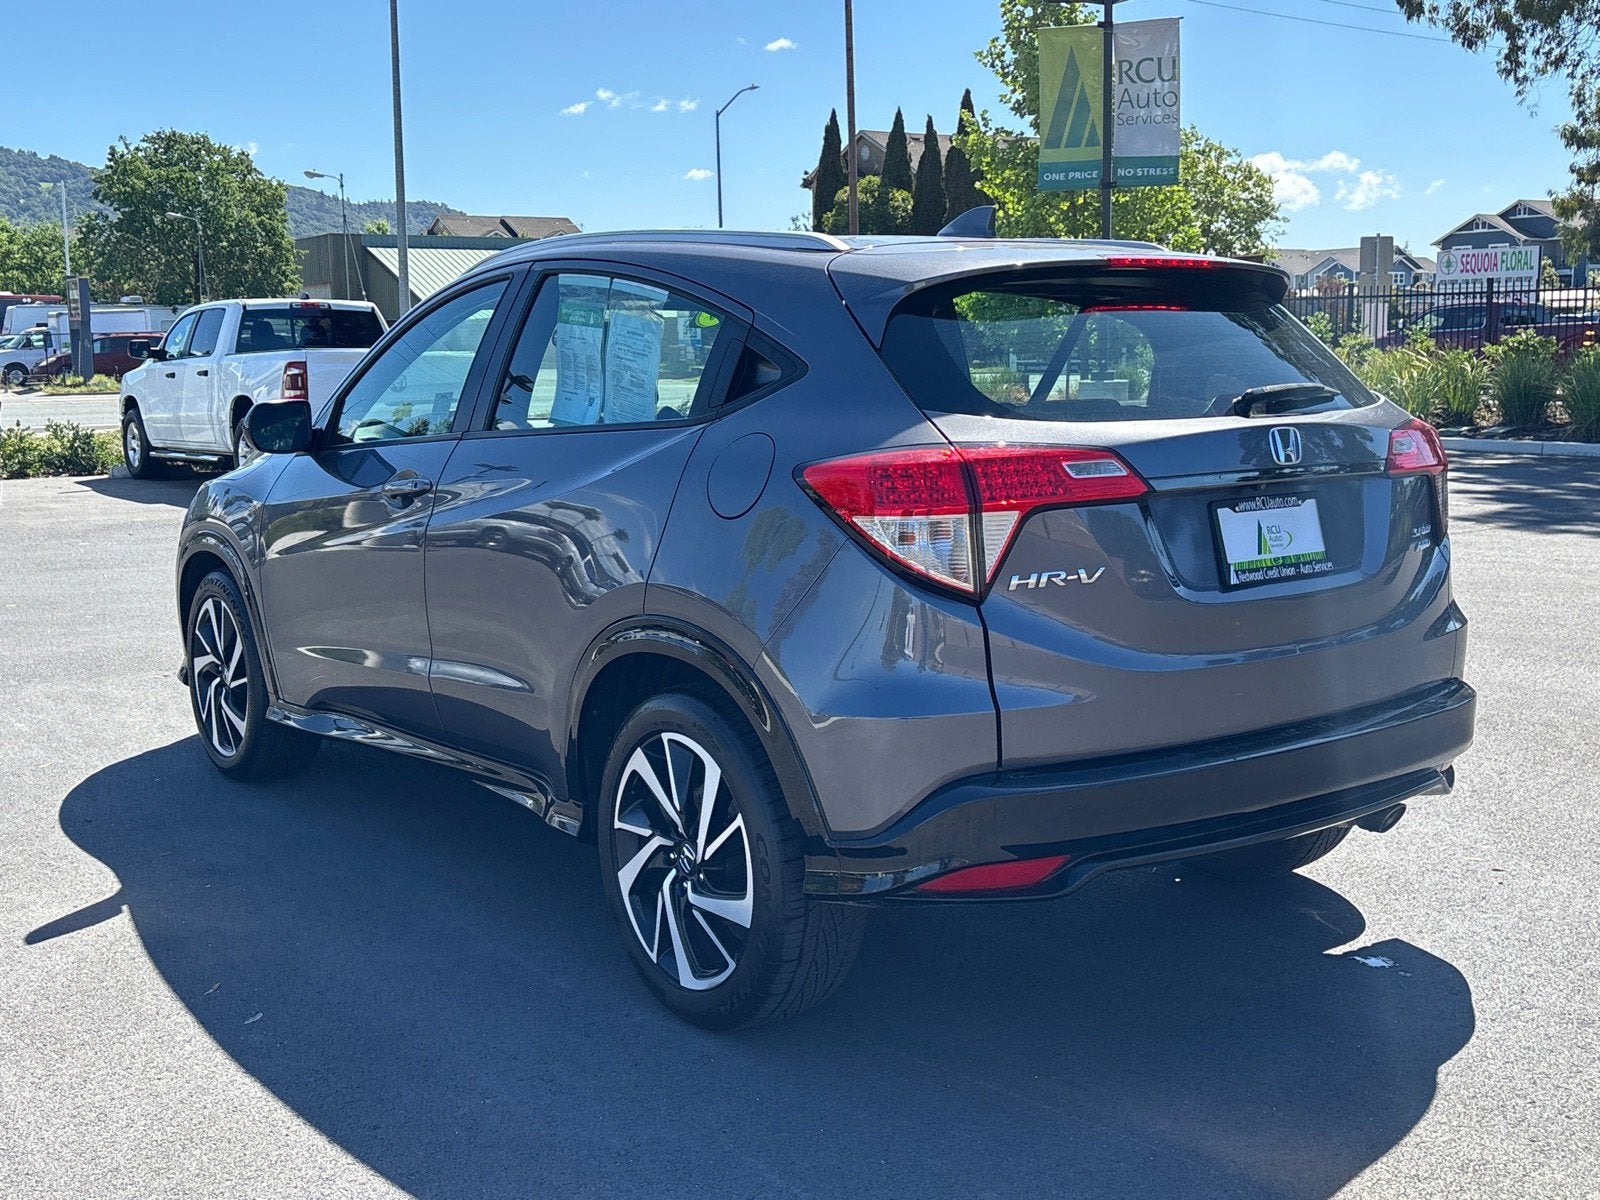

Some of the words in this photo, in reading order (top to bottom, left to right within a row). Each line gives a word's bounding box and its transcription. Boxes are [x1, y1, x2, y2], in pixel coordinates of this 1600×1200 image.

[1117, 56, 1177, 85] RCU
[1117, 88, 1178, 110] Auto
[1116, 111, 1178, 126] Services
[1043, 172, 1065, 181] ONE
[1068, 170, 1098, 180] PRICE
[1117, 168, 1135, 177] NO
[1136, 167, 1175, 176] STRESS
[1460, 251, 1498, 275] SEQUOIA
[1500, 249, 1534, 272] FLORAL
[1238, 496, 1299, 511] www.RCUauto.com
[1266, 525, 1281, 535] RCU
[1008, 566, 1106, 591] HR-V
[1238, 568, 1263, 583] Redwood
[1263, 567, 1280, 579] Credit
[1280, 565, 1296, 577] Union
[1300, 563, 1313, 574] Auto
[1312, 561, 1334, 573] Services
